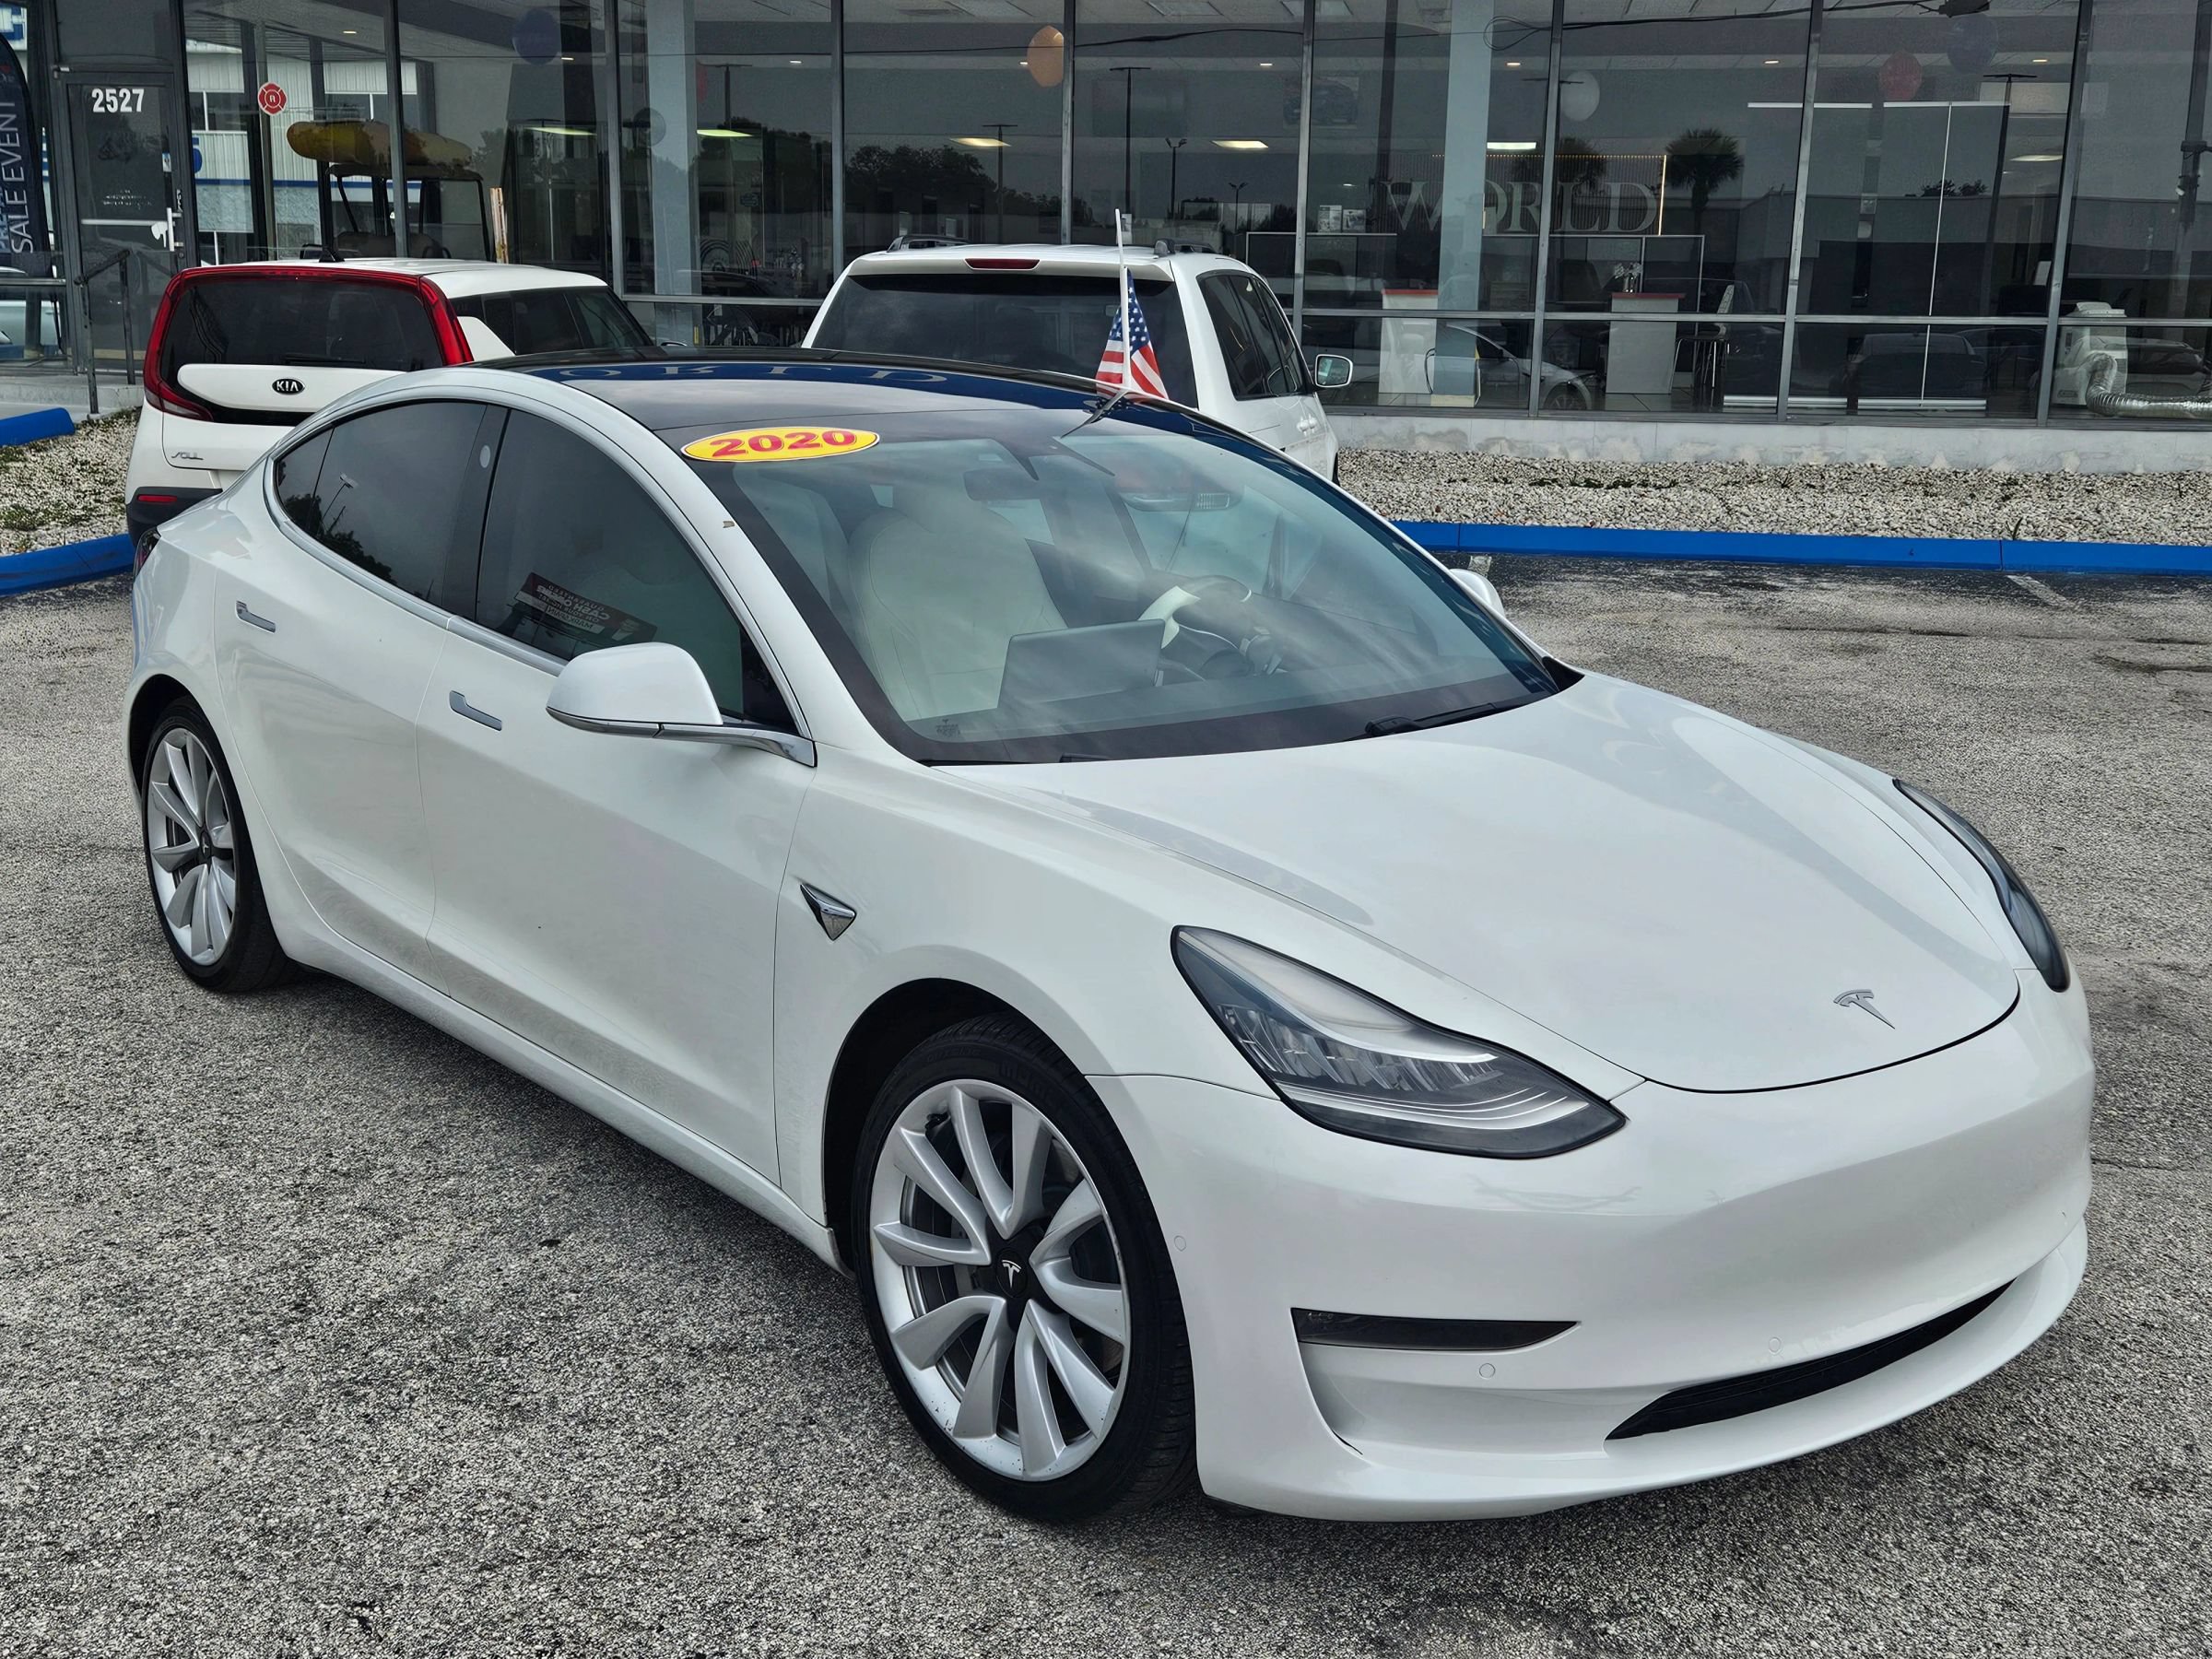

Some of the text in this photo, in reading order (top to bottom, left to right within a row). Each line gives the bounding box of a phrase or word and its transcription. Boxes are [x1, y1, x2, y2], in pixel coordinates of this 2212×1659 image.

[91, 88, 145, 113] 2527
[5, 189, 34, 253] SALE
[276, 381, 300, 392] KIA
[709, 429, 858, 457] 2020
[171, 452, 204, 460] SOUL
